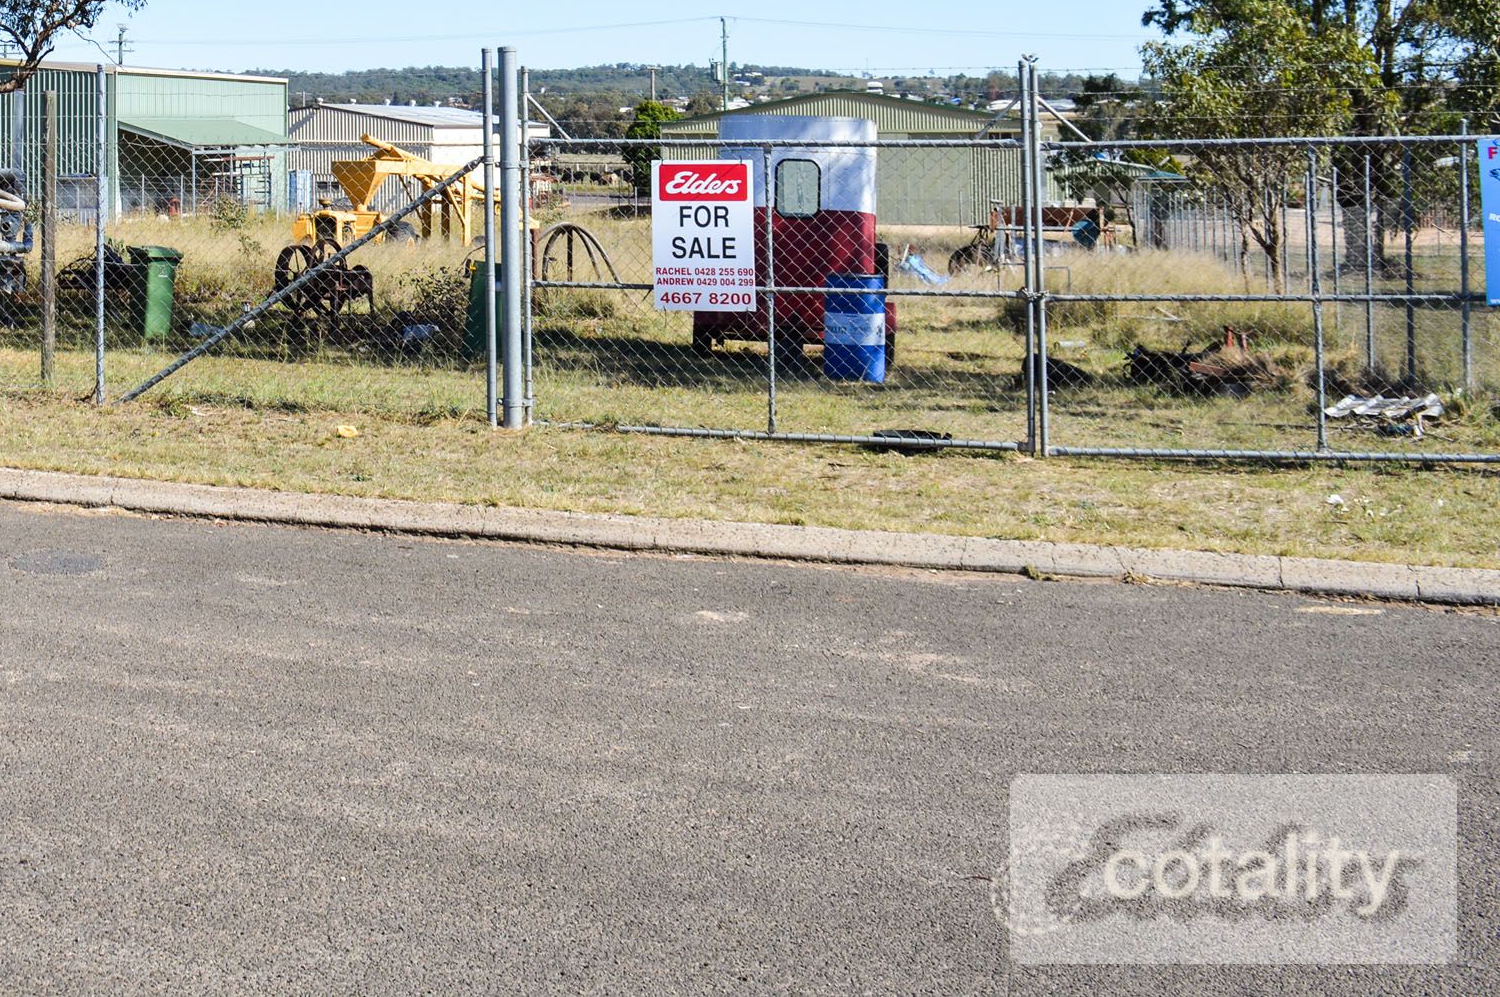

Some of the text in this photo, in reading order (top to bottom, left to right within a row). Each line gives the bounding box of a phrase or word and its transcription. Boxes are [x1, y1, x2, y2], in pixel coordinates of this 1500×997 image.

[665, 171, 742, 195] Elders
[679, 205, 729, 228] FOR
[672, 236, 736, 259] SALE
[655, 267, 754, 276] RACHEL 0428 255 690
[657, 277, 754, 287] ANDREW 0429 004 299
[660, 292, 752, 305] 4667 8200
